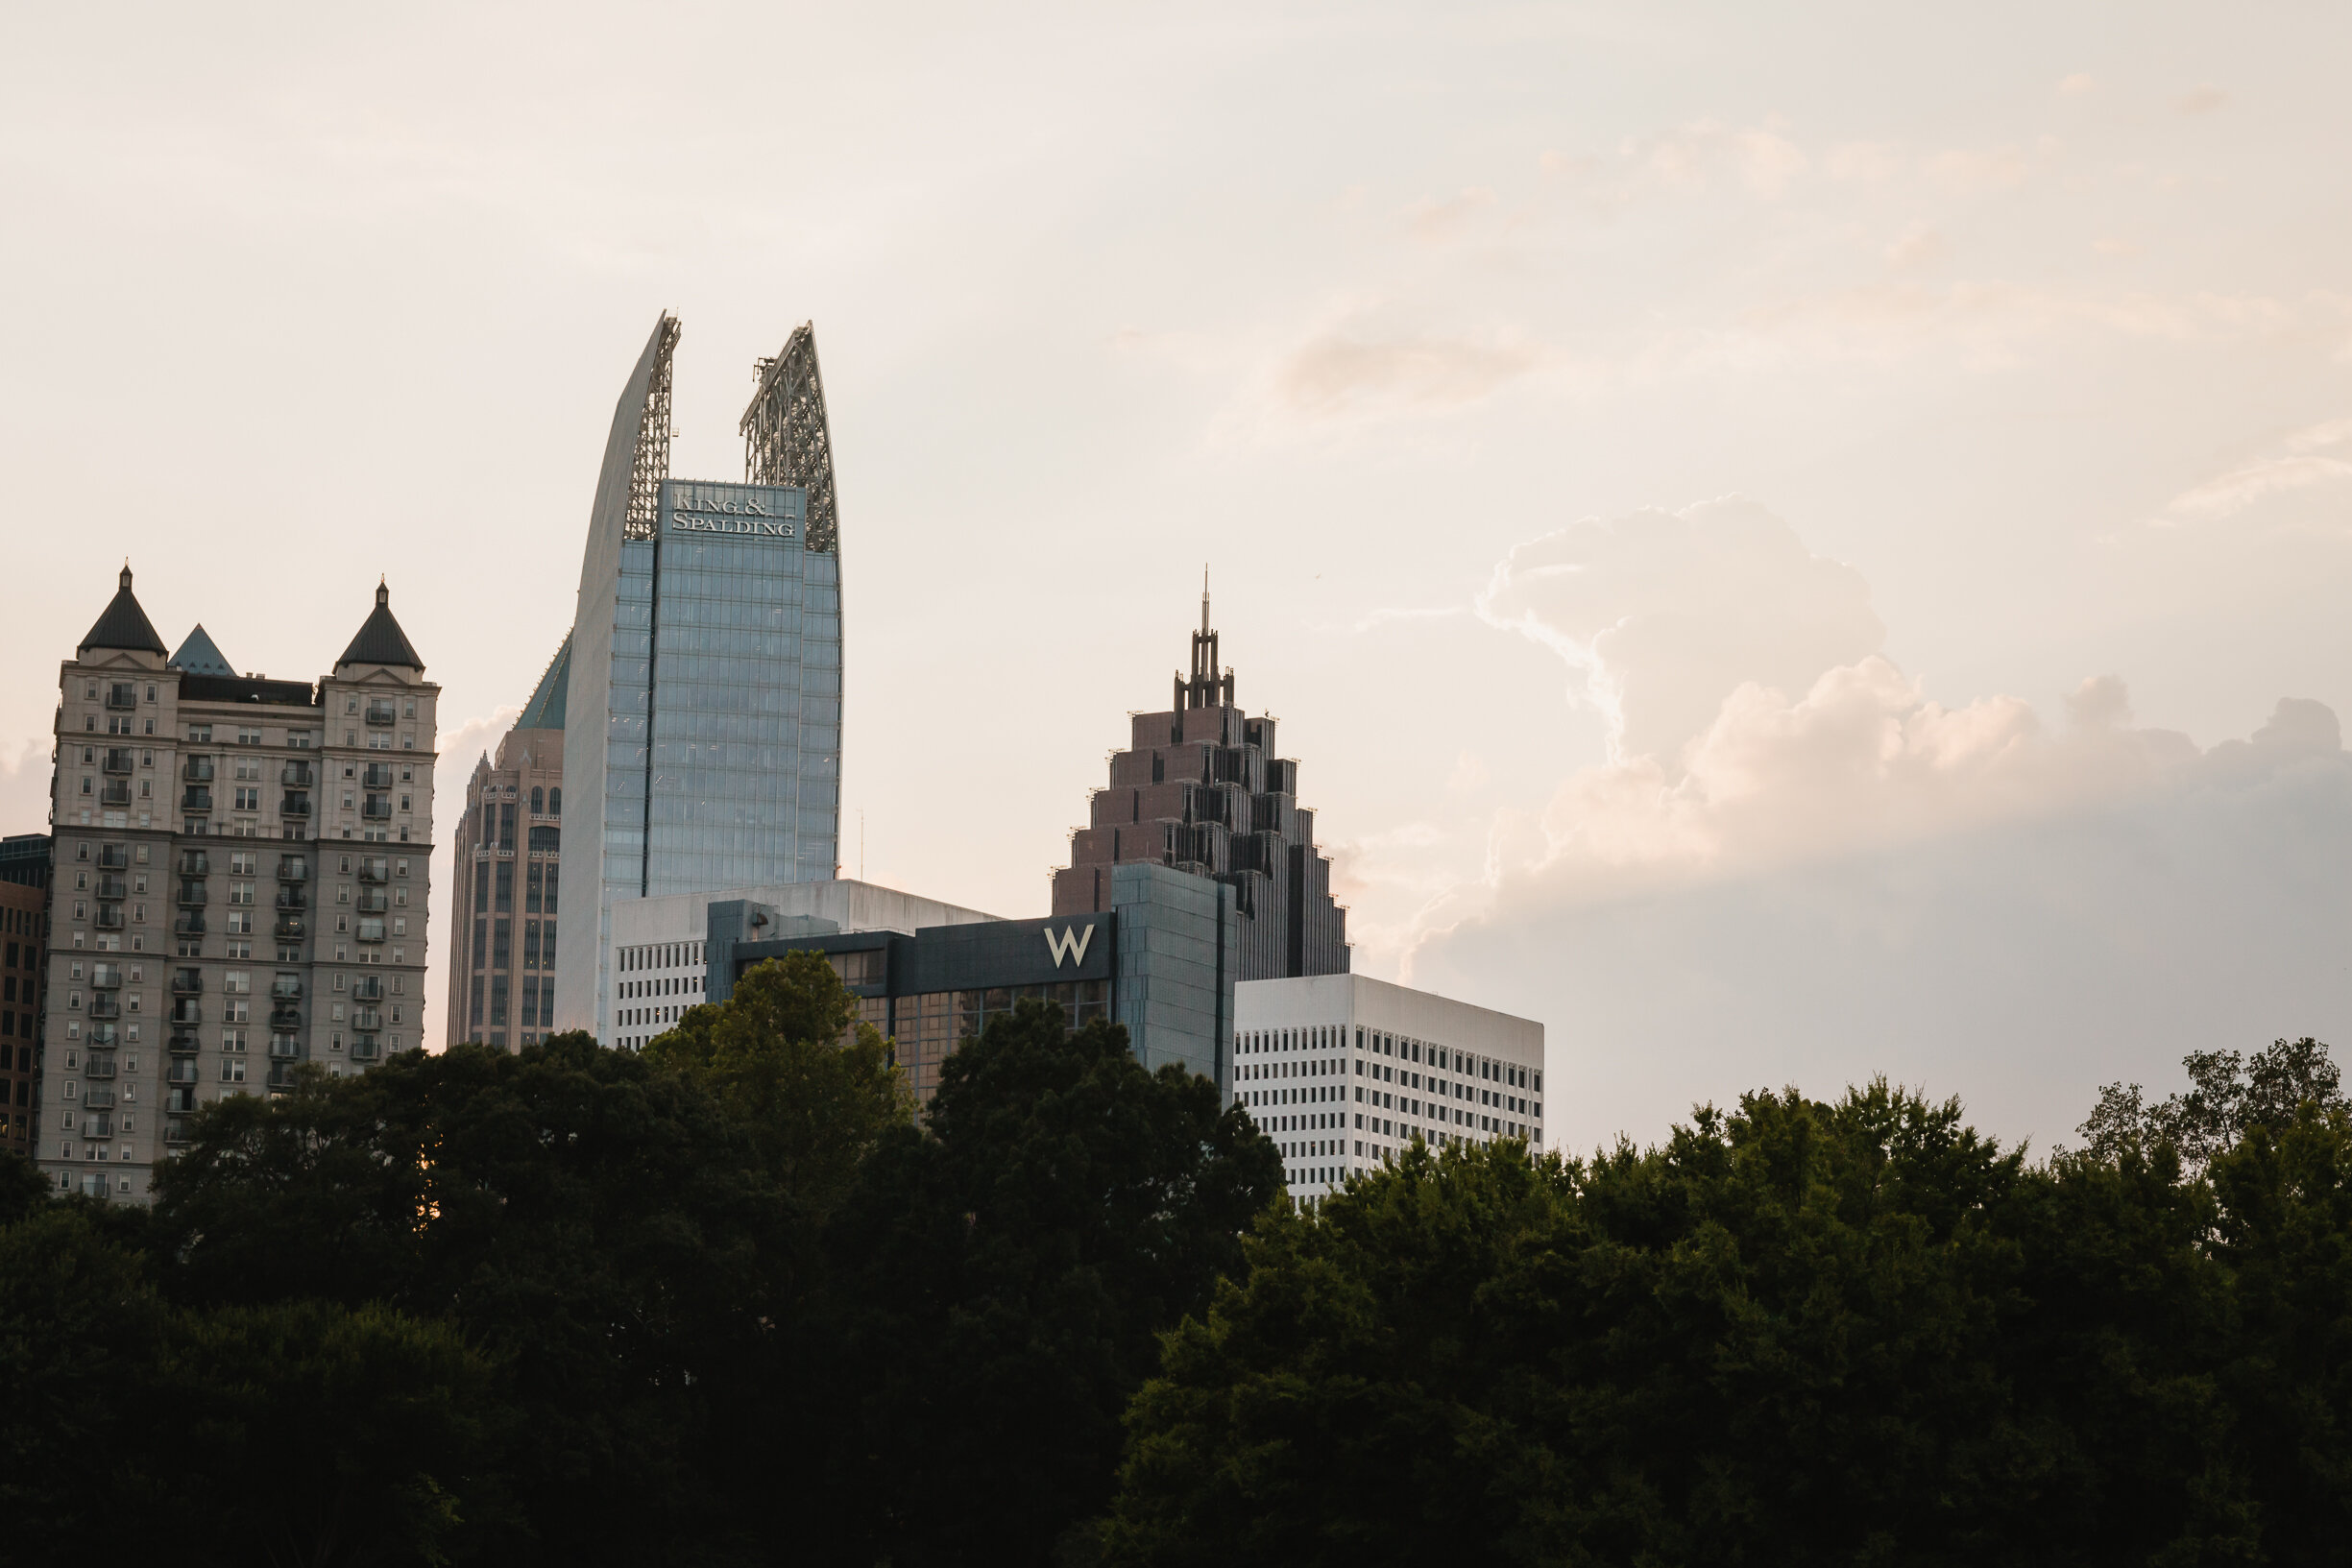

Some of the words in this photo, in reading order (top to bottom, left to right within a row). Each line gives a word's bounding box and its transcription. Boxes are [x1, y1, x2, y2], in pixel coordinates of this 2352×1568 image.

[674, 495, 739, 514] KING
[744, 498, 766, 515] &
[672, 513, 795, 536] SPALDING
[1044, 924, 1095, 969] W
